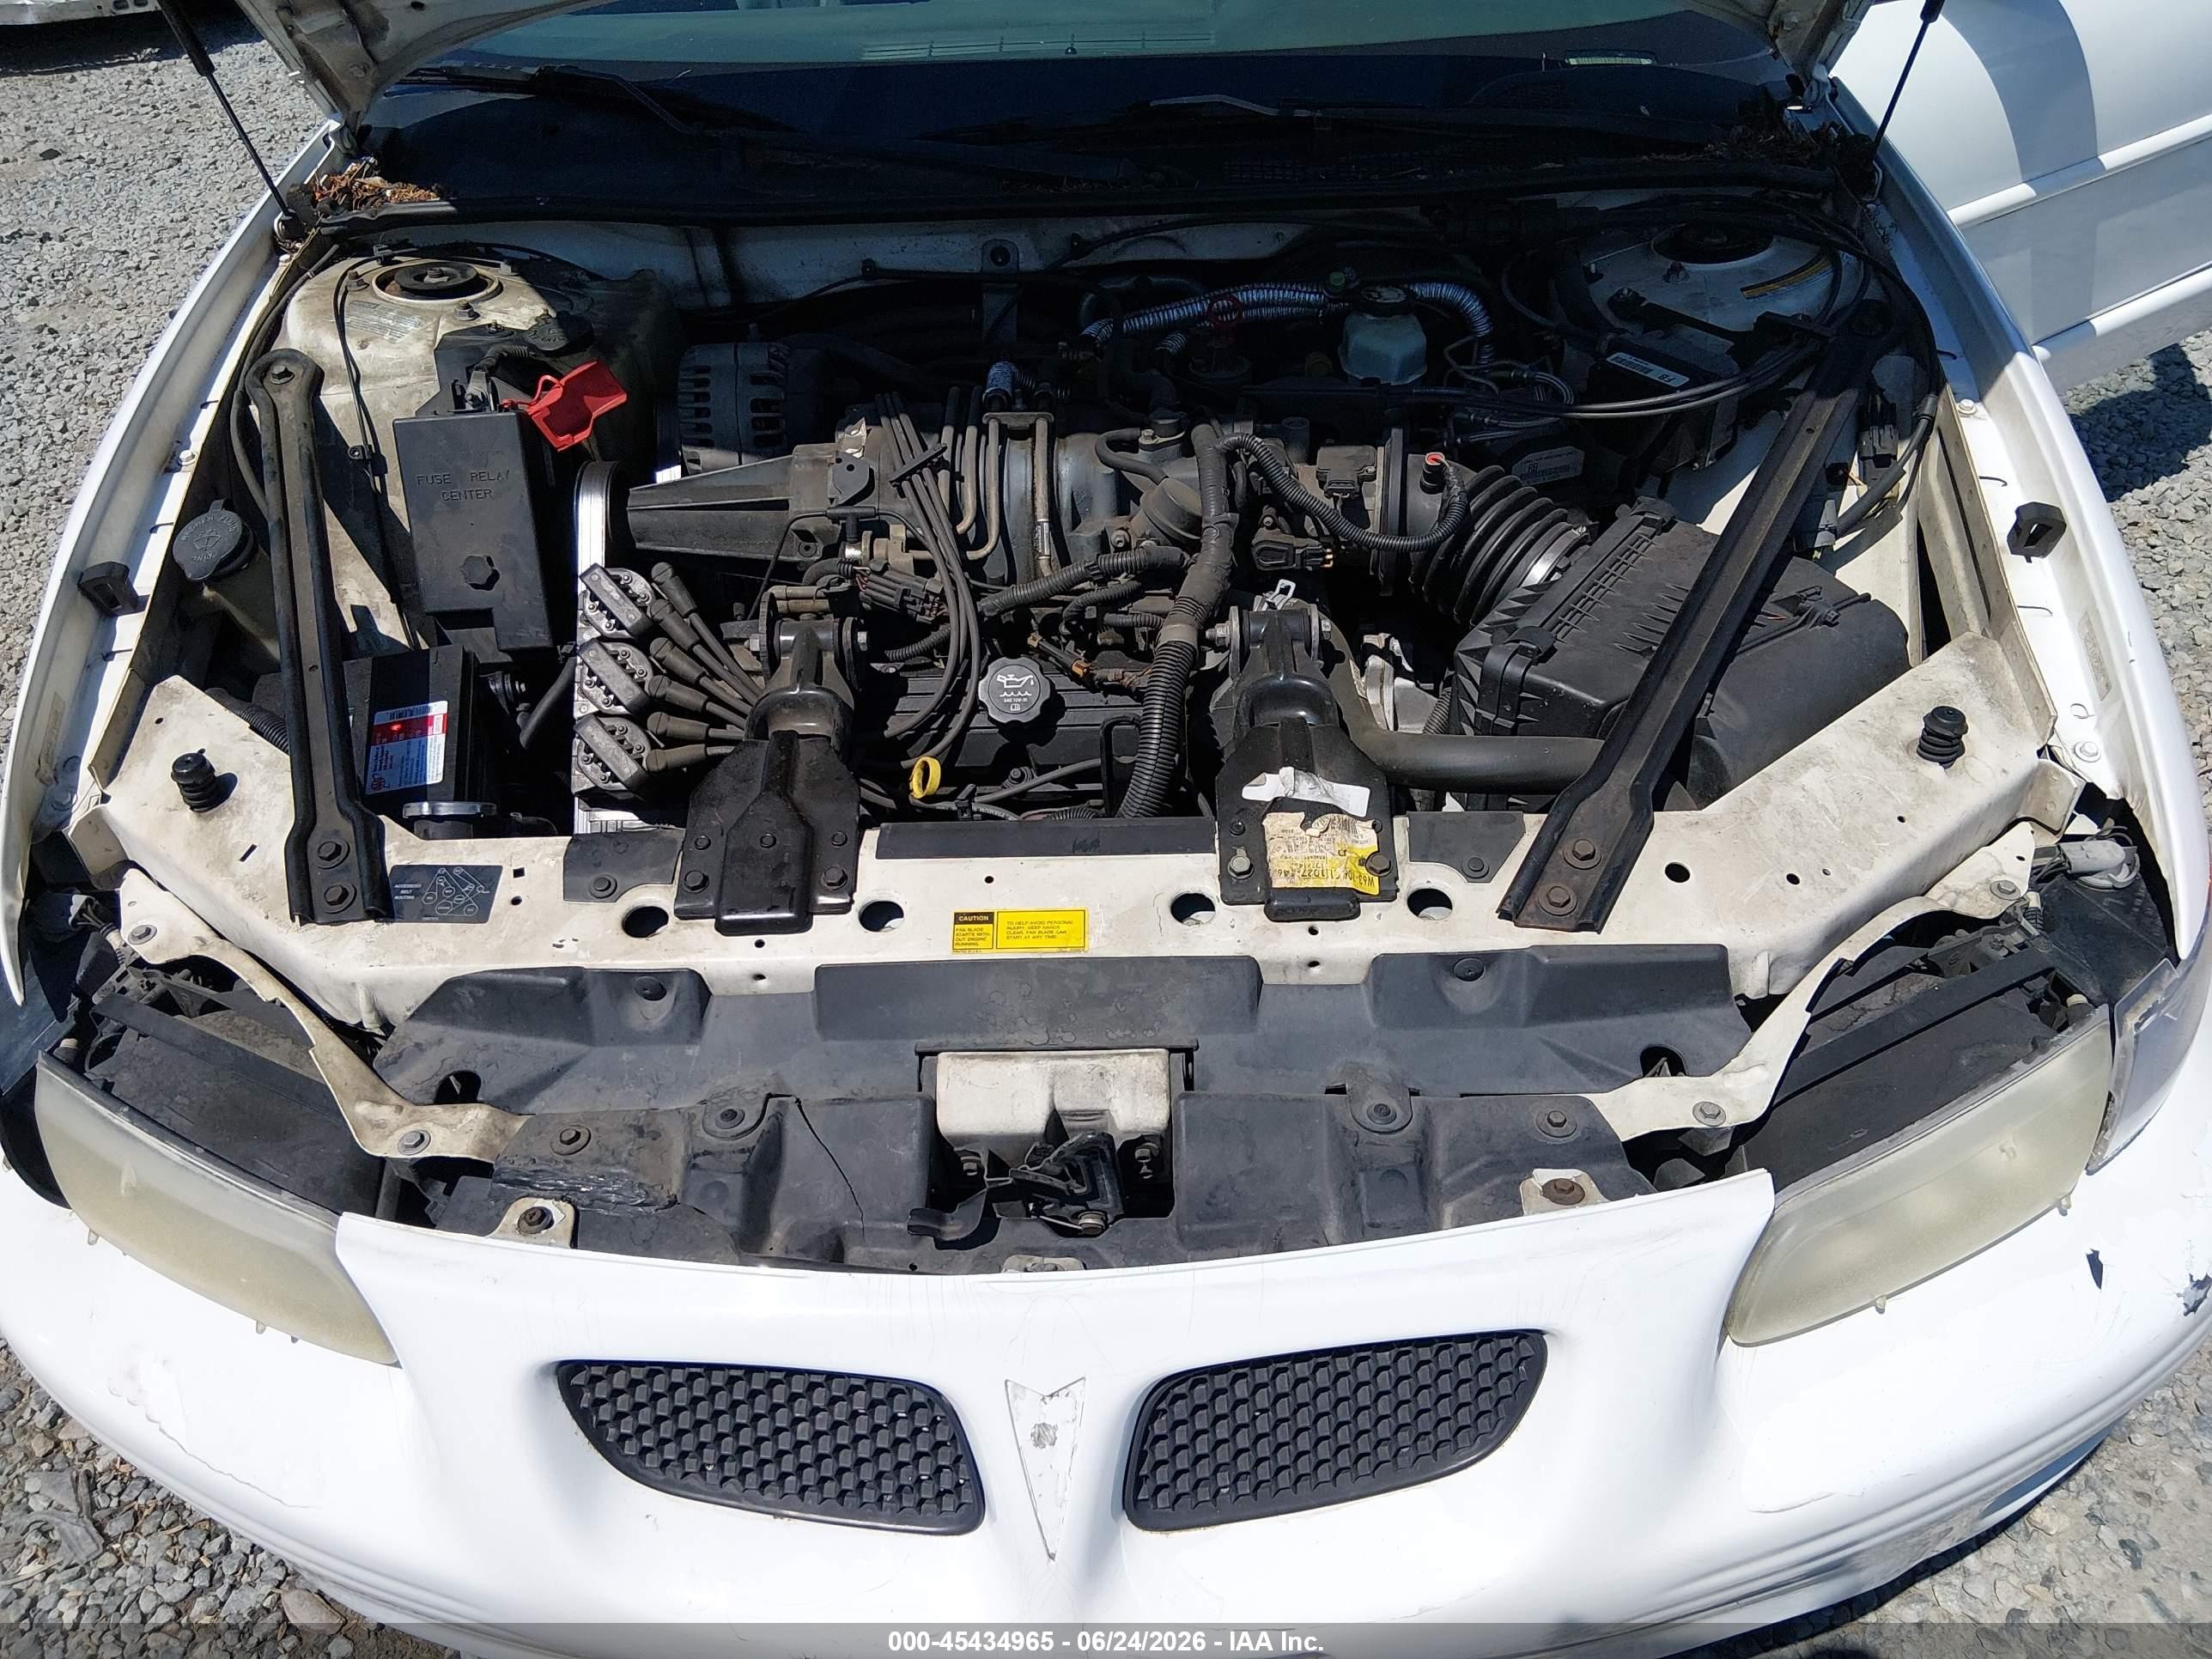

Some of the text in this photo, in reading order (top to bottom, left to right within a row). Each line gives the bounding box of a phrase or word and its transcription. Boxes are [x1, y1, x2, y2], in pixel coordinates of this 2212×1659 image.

[416, 470, 510, 487] FUSE RELAY
[441, 489, 492, 501] CENTER
[220, 515, 237, 533] FLUID
